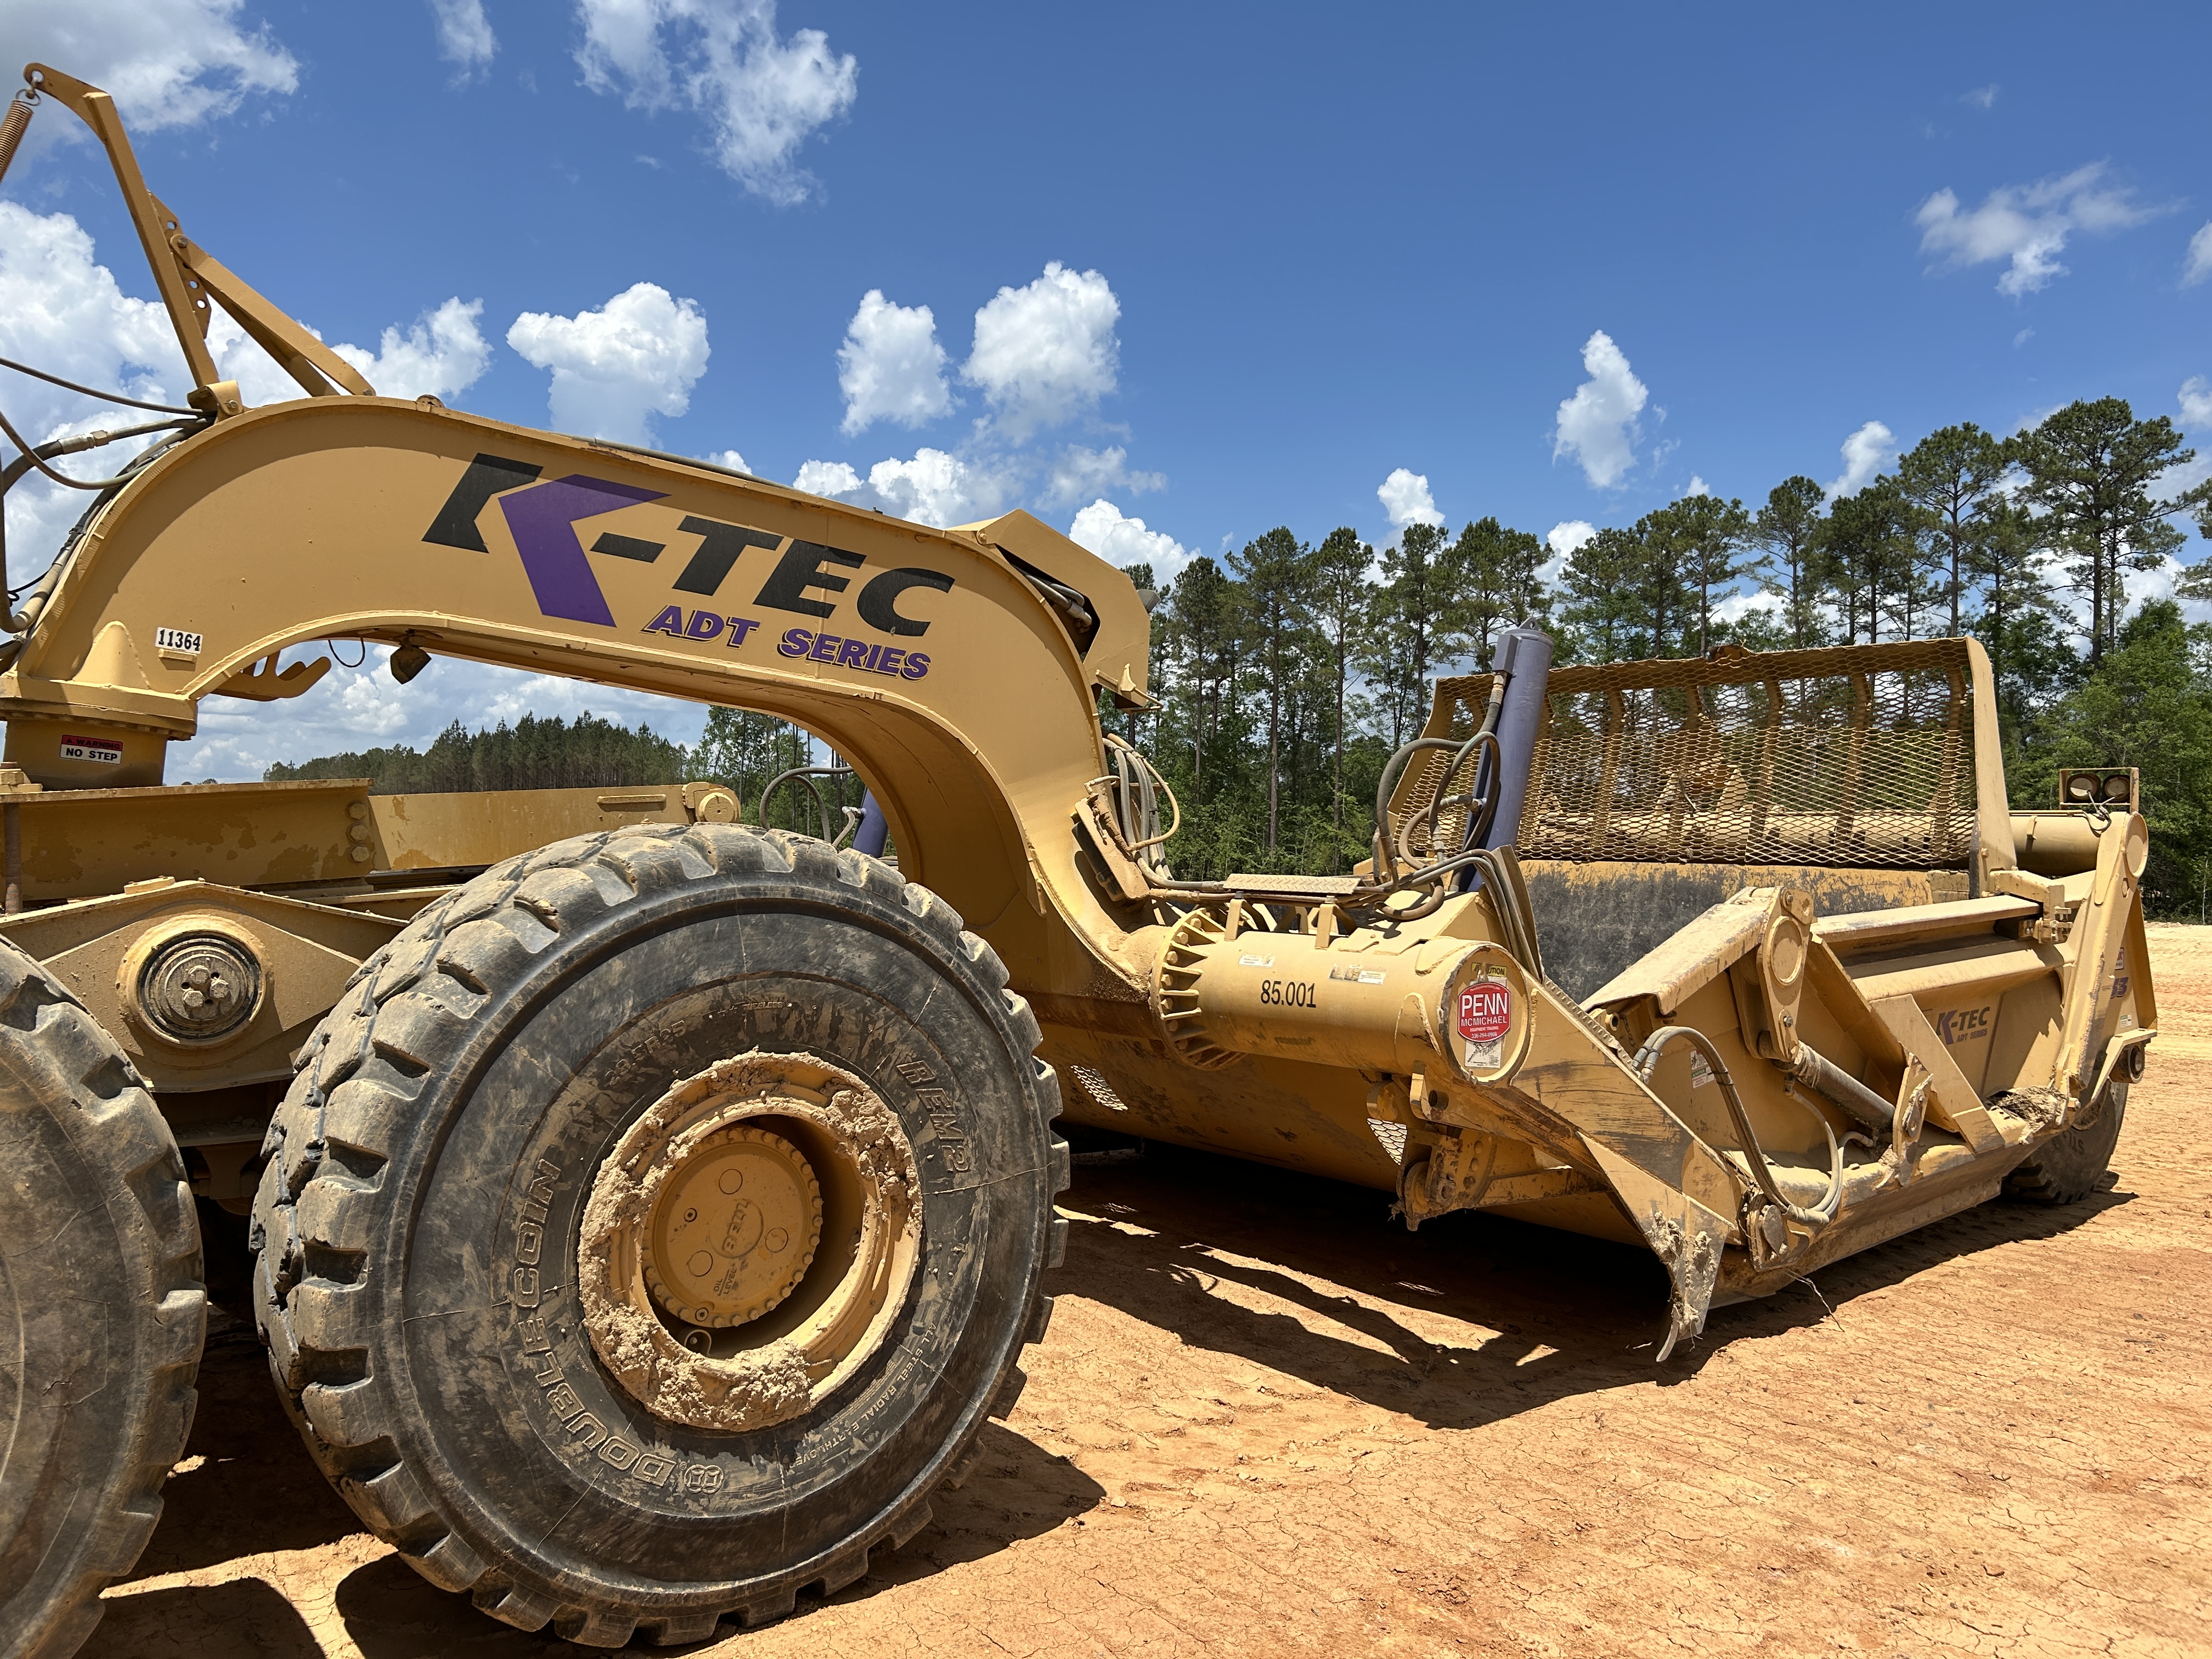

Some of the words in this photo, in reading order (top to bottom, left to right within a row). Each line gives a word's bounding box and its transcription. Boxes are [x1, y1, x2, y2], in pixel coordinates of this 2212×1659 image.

[421, 453, 955, 636] K-TEC
[158, 629, 201, 651] 11364
[640, 605, 761, 650] ADT
[777, 628, 932, 681] SERIES
[66, 748, 83, 757] NO
[88, 751, 118, 761] STEP
[76, 738, 120, 749] WARNING
[1260, 979, 1317, 1008] 85.001
[1462, 992, 1508, 1017] PENN
[1461, 1016, 1508, 1027] MCMICHAEL
[1935, 1006, 1990, 1045] K-TEC
[1956, 1032, 1968, 1042] ADT
[1970, 1028, 1988, 1040] SERIES
[896, 1060, 971, 1173] REM2
[514, 1158, 561, 1309] COIN
[713, 1278, 723, 1293] OIL
[723, 1268, 737, 1295] LEVEL
[921, 1322, 936, 1344] ALL
[896, 1347, 923, 1383] STEEL
[517, 1317, 676, 1487] DOUBLE
[861, 1385, 898, 1421] RADIAL
